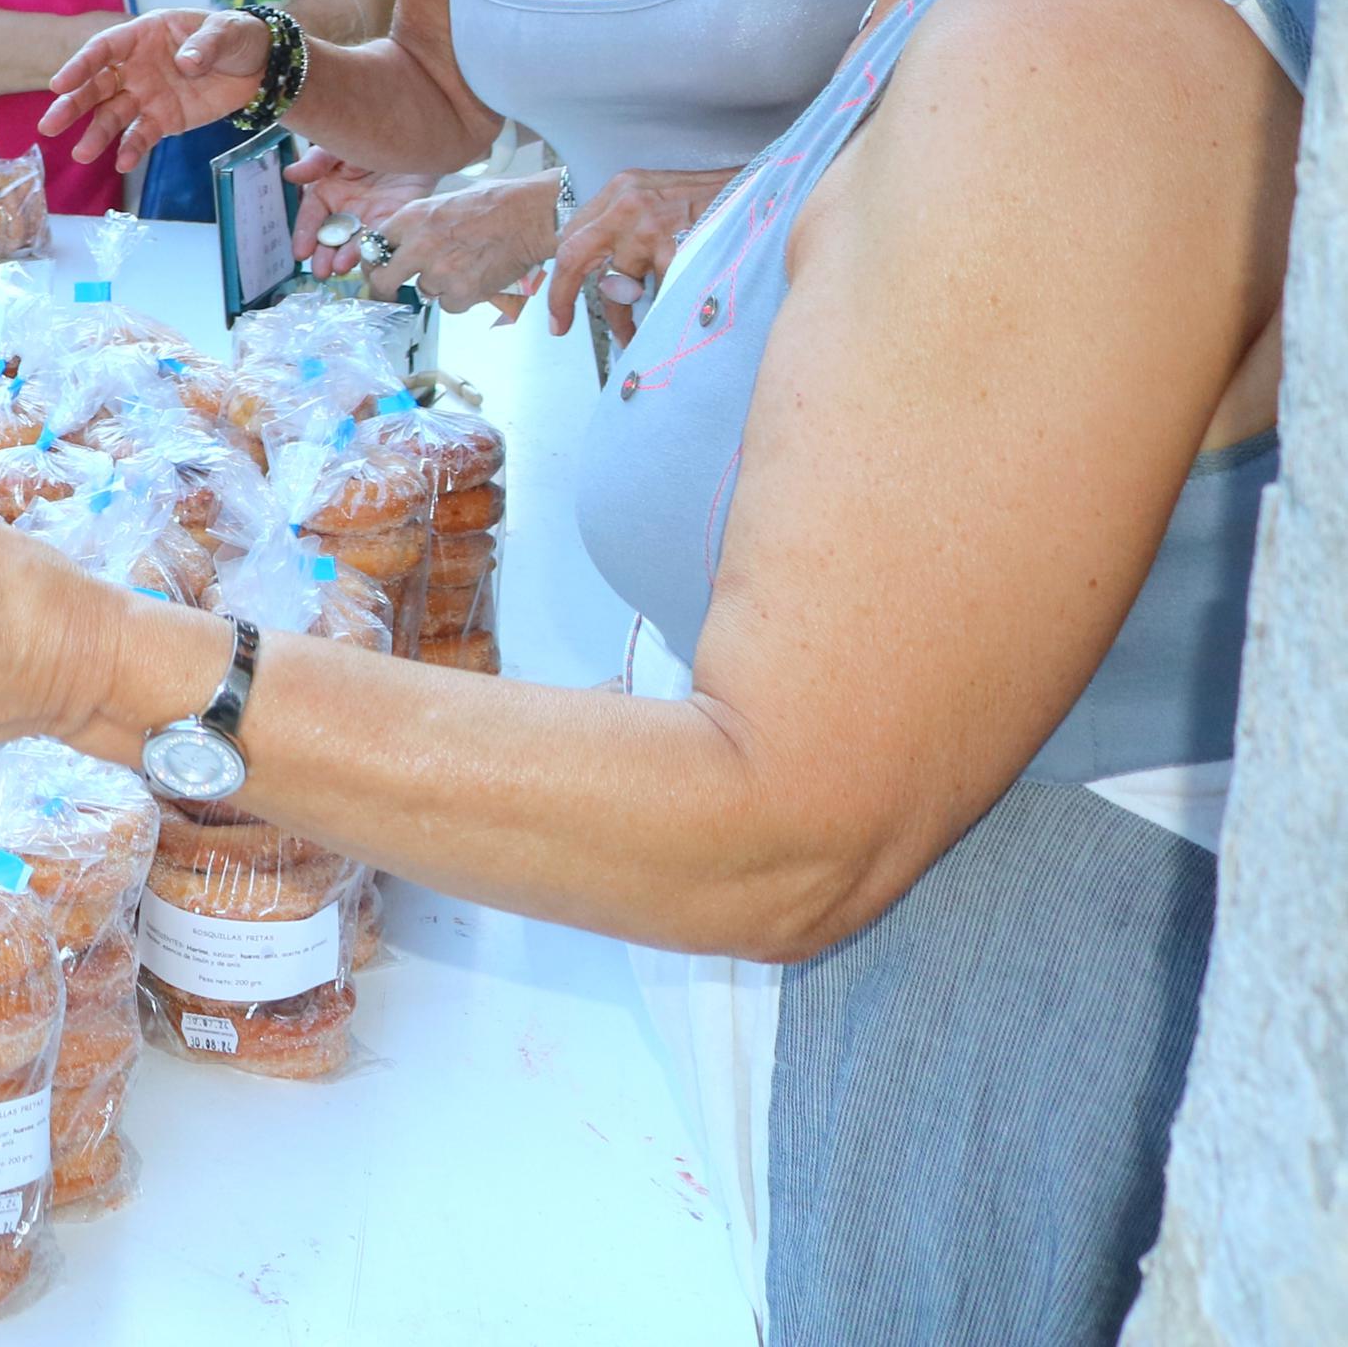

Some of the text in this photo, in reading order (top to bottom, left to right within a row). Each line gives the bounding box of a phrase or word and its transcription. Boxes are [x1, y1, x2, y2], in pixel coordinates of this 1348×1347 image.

[192, 928, 275, 942] ROSQUILLAS FRITAS
[235, 979, 249, 987] 200
[189, 1035, 233, 1053] 30.08.24
[8, 1155, 22, 1166] 200
